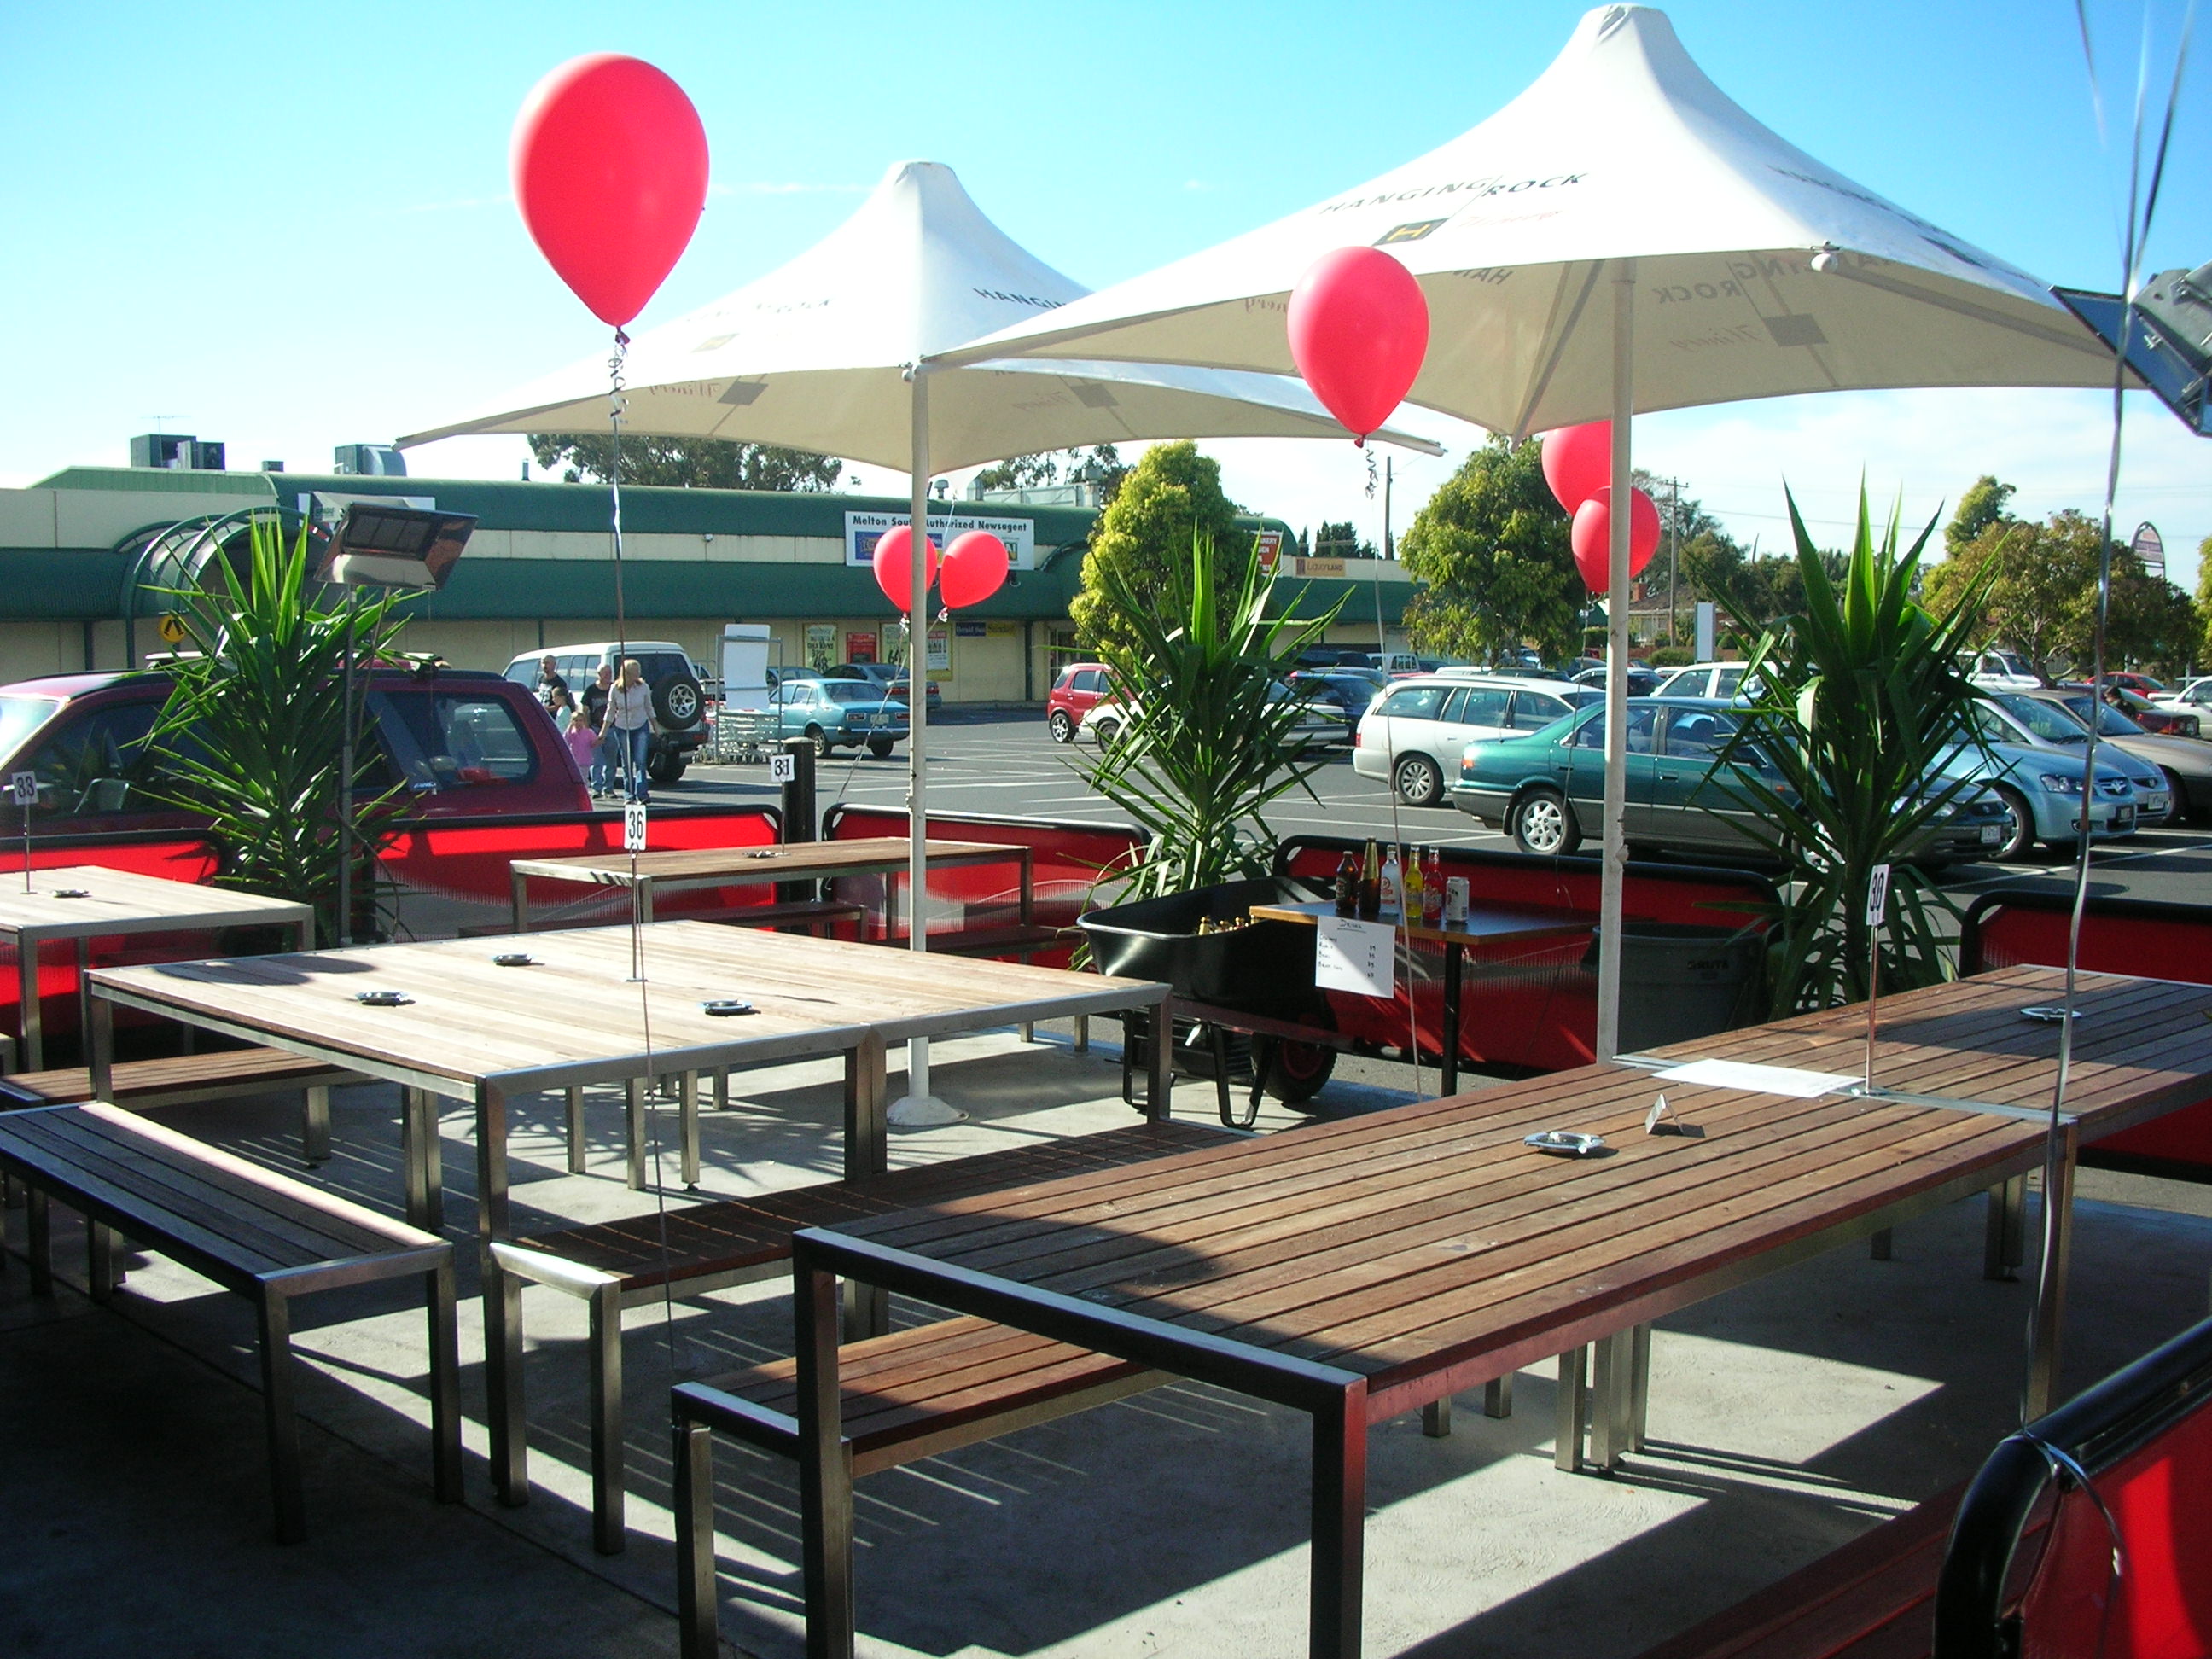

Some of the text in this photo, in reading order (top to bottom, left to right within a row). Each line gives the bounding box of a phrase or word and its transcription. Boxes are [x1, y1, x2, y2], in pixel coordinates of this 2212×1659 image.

[1319, 172, 1588, 214] HANGING ROCK
[853, 515, 887, 527] Melton
[891, 516, 912, 527] Sout
[978, 520, 1027, 533] Newsagent
[775, 758, 789, 777] 31
[17, 776, 34, 798] 33
[628, 810, 643, 840] 36
[1870, 871, 1884, 911] 30
